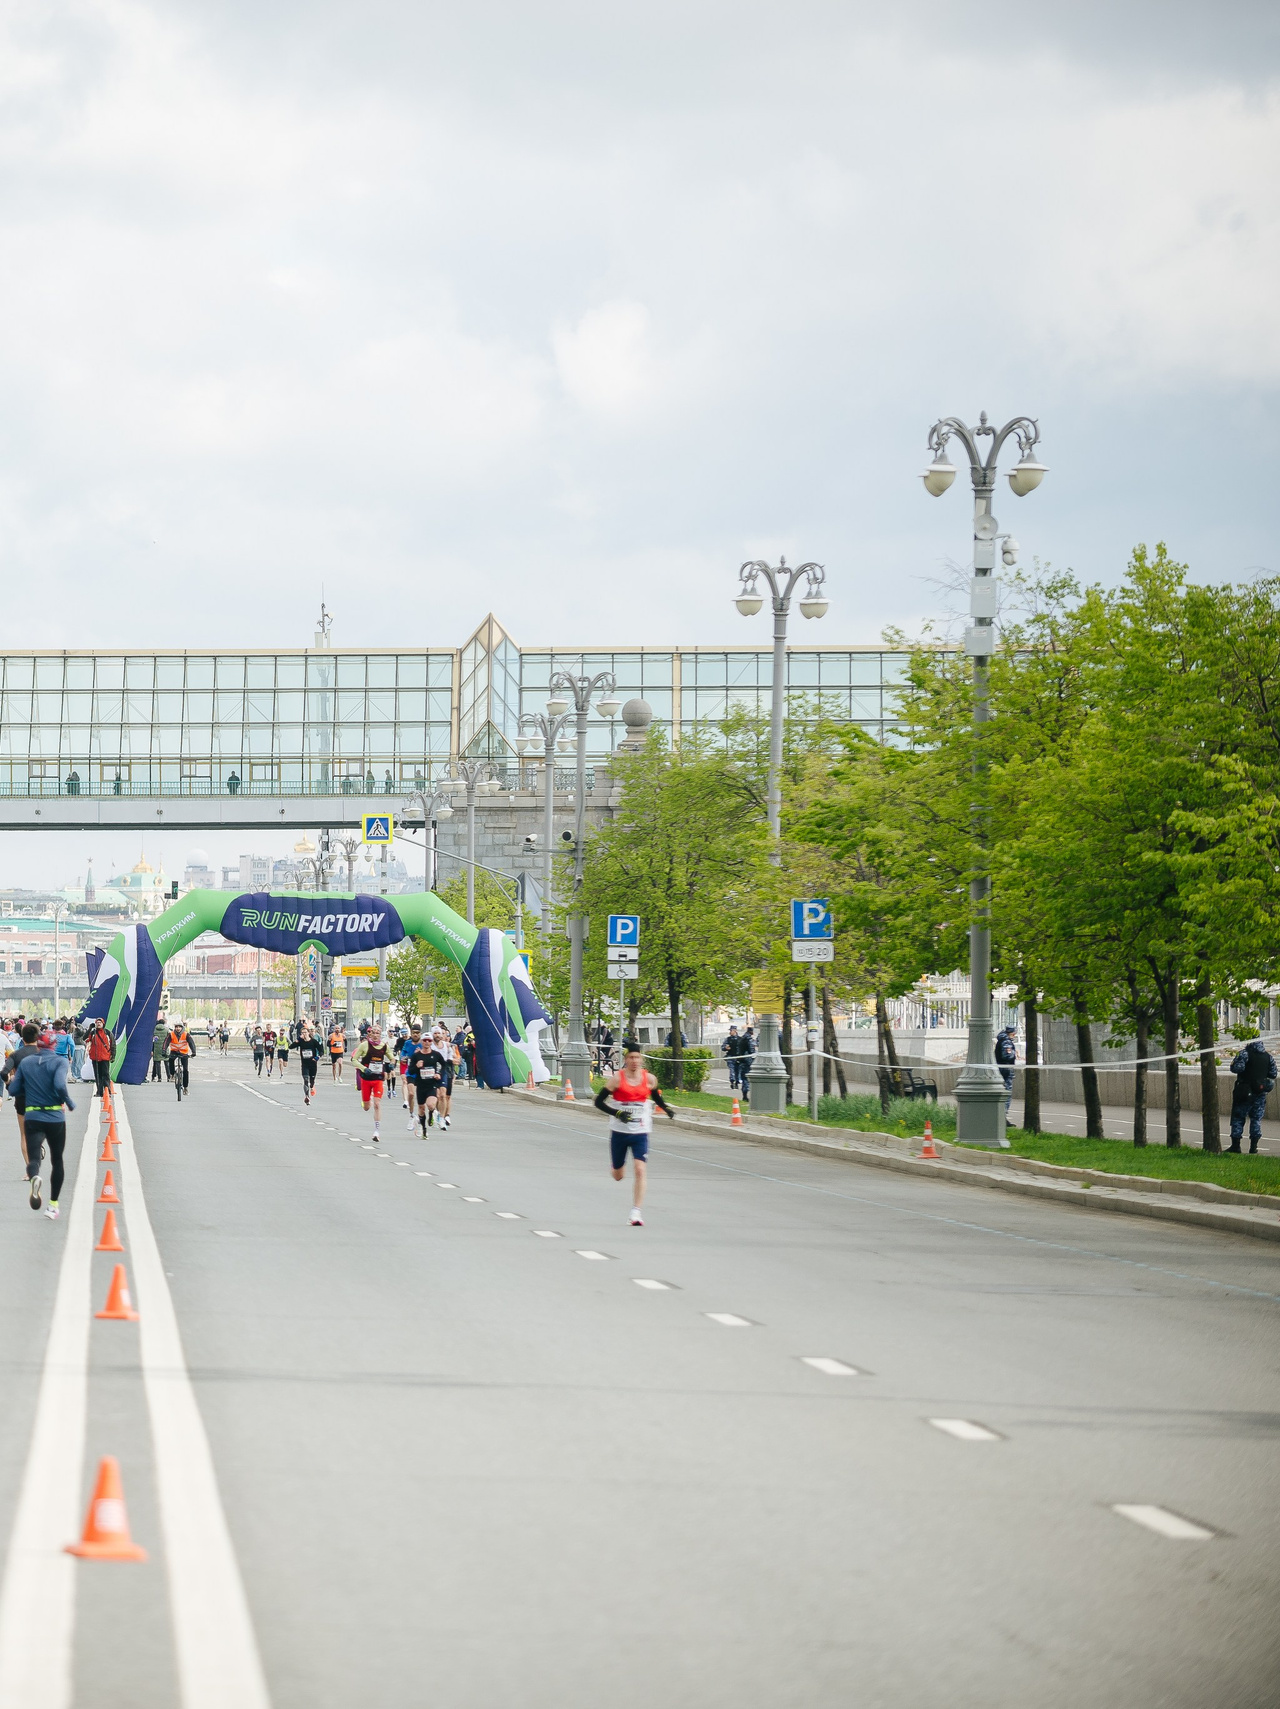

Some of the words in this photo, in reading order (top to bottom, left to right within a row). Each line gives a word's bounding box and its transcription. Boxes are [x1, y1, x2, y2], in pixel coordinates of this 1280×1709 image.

[155, 911, 196, 944] УРАЛХИМ
[430, 916, 471, 949] УРАЛХИМ
[616, 918, 634, 942] P
[816, 947, 829, 956] 20
